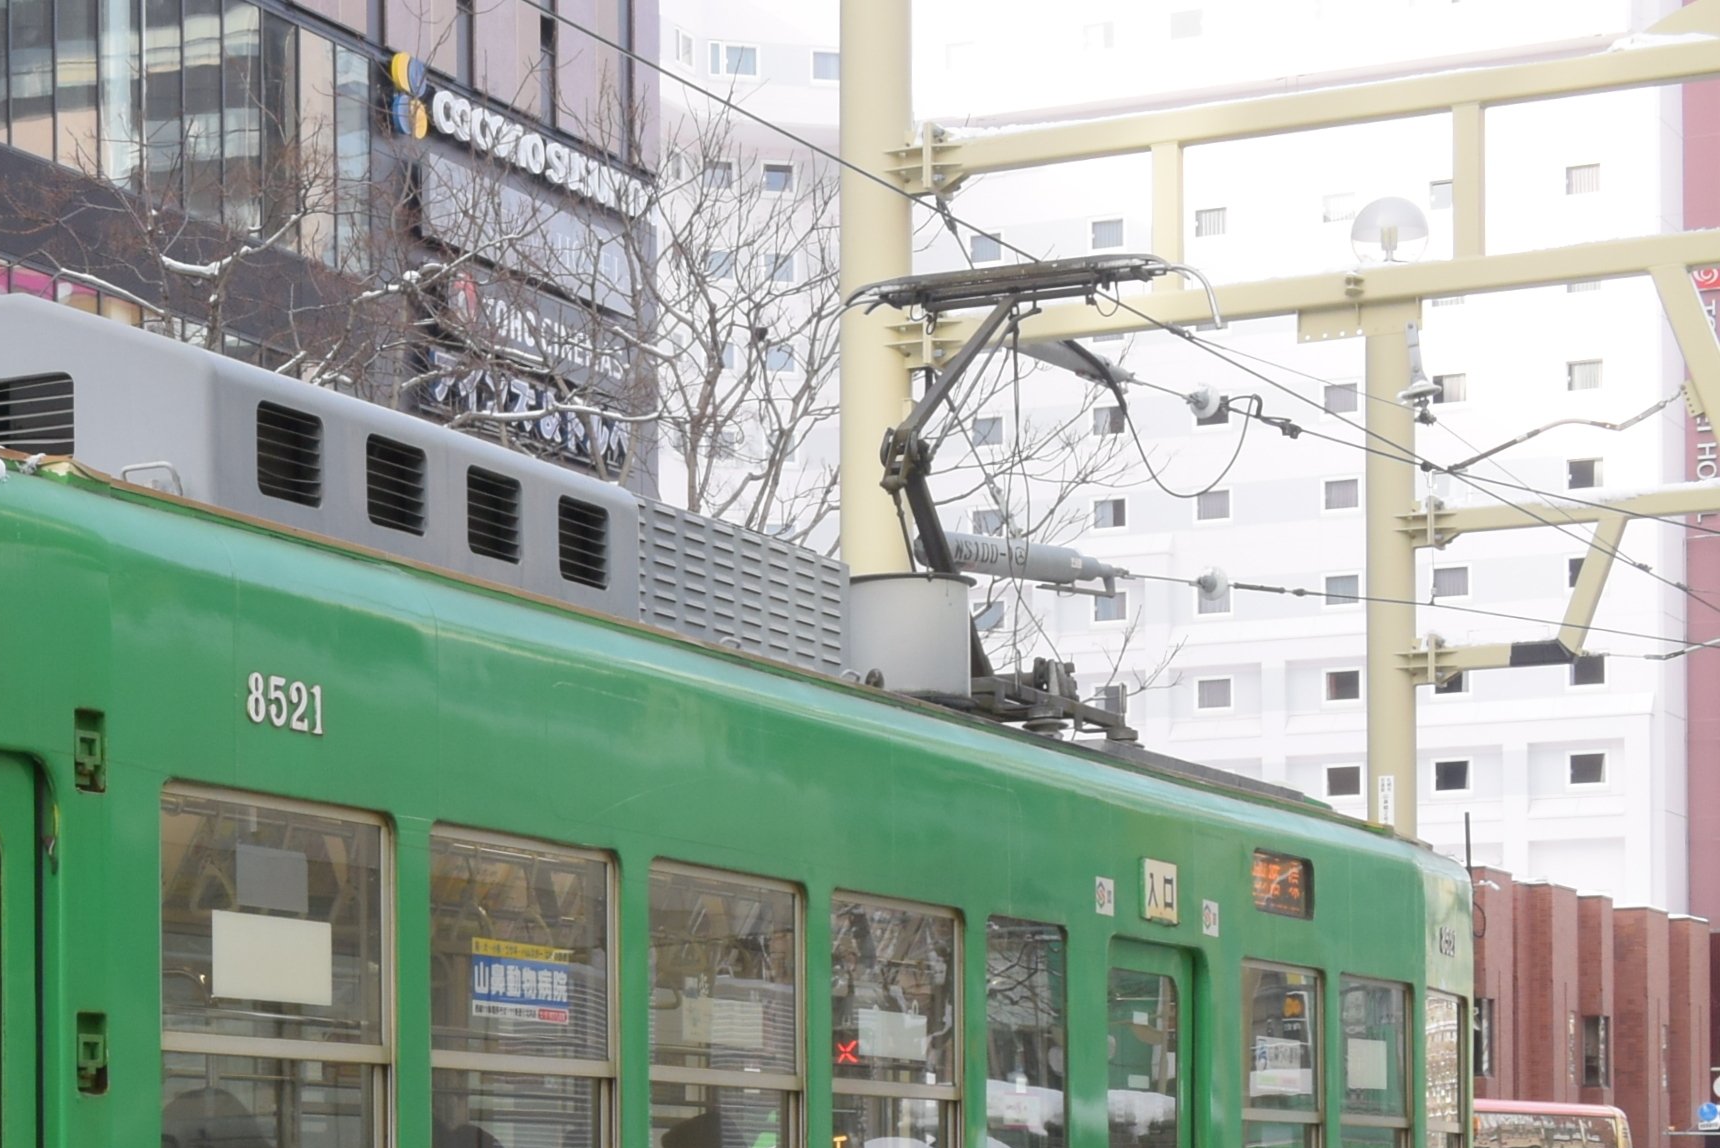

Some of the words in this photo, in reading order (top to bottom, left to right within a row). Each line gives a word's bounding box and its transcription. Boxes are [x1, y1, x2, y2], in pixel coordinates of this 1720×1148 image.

[482, 296, 537, 347] TOHO
[245, 670, 324, 736] 8521
[1147, 872, 1175, 912] 入口
